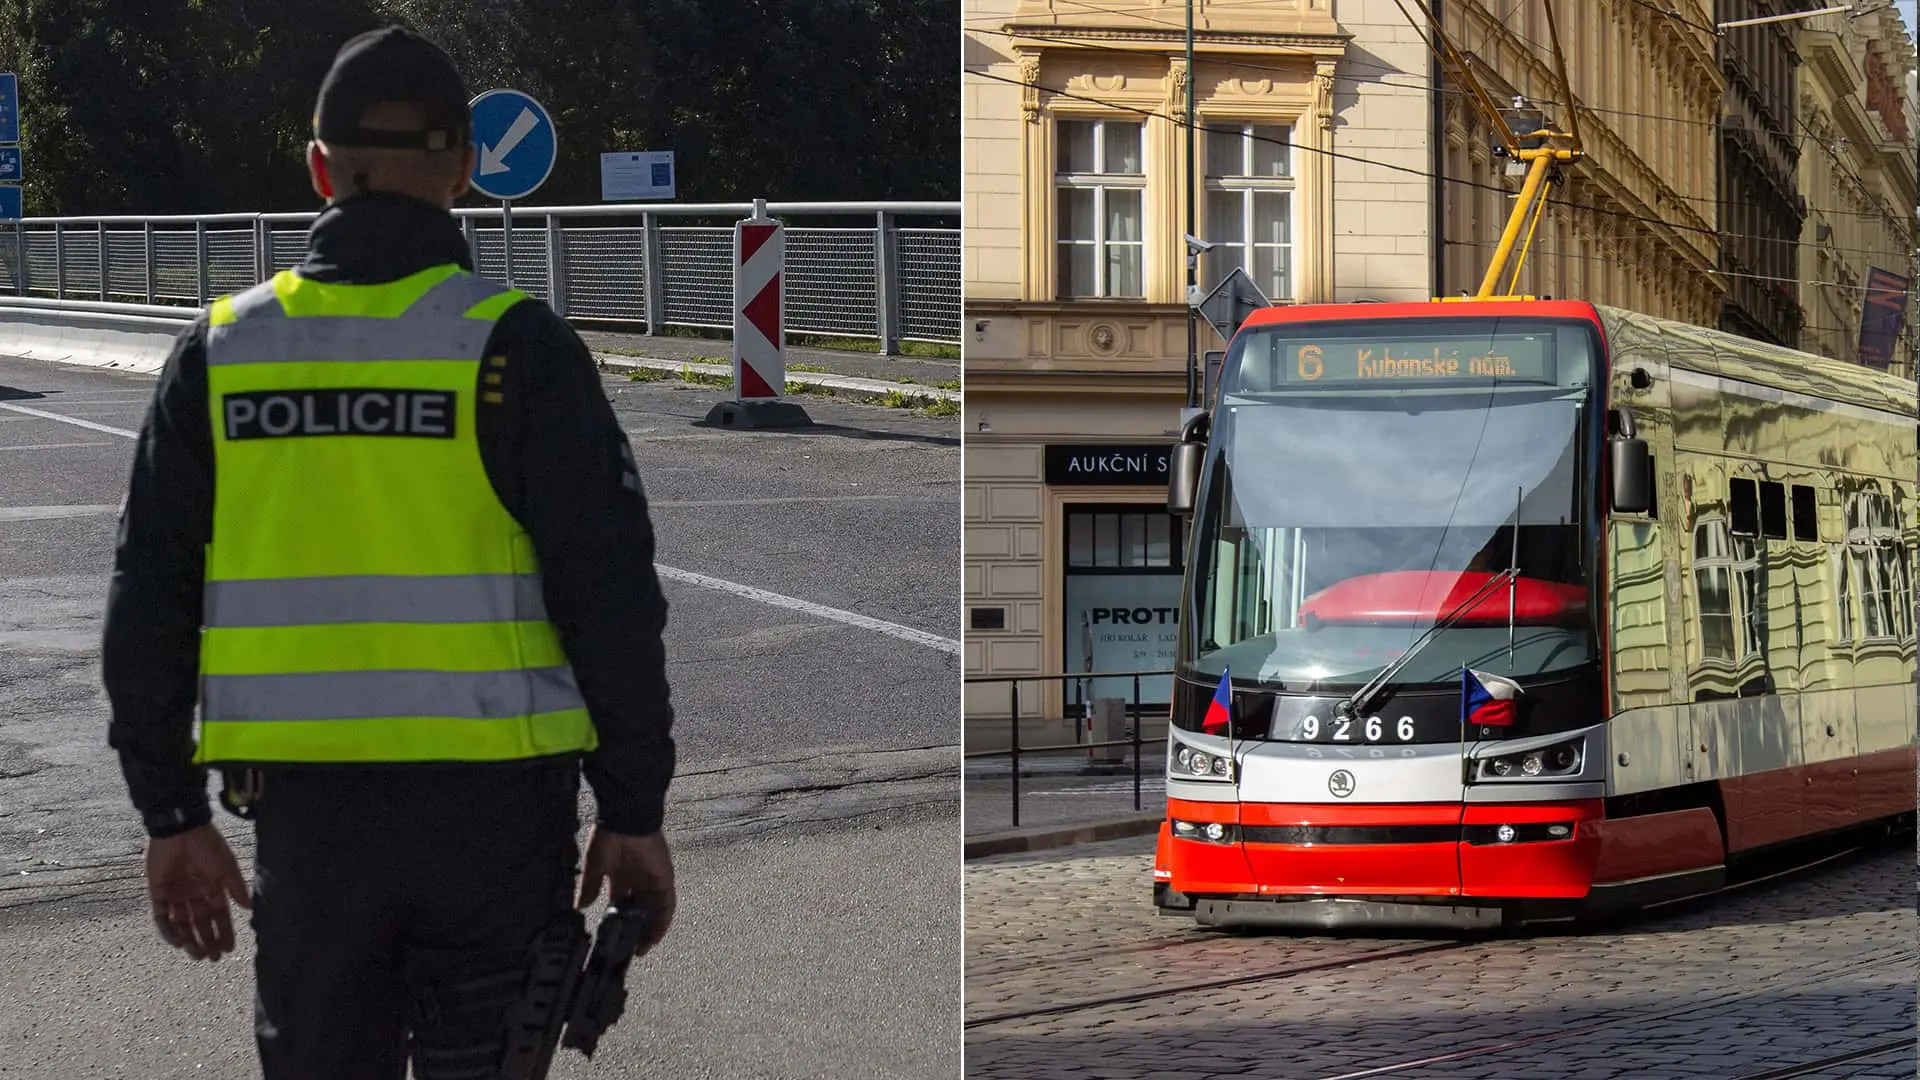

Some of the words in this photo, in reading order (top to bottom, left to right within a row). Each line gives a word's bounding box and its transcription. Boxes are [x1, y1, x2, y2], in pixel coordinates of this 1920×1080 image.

[1298, 344, 1324, 381] 6
[1357, 348, 1459, 379] Kubánské
[1469, 350, 1517, 376] nám.
[226, 393, 447, 437] POLICIE
[1068, 453, 1148, 472] AUKČNÍ
[1303, 715, 1415, 741] 9266
